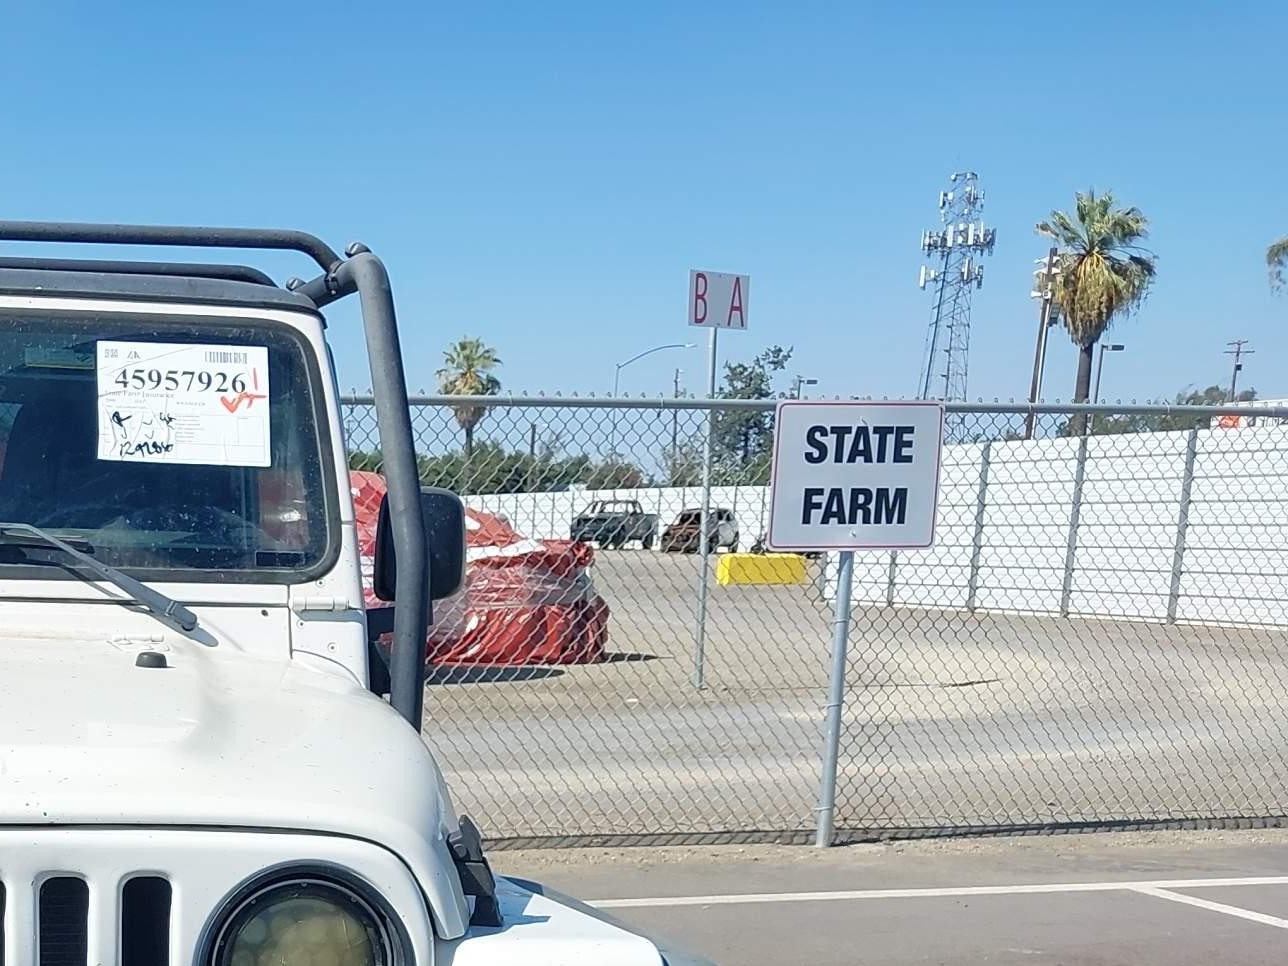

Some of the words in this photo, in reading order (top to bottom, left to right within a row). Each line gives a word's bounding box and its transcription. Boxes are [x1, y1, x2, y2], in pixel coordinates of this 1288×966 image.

[694, 272, 708, 324] B
[727, 276, 744, 328] A
[114, 368, 246, 393] 45957926
[804, 425, 915, 464] STATE
[801, 487, 908, 525] FARM
